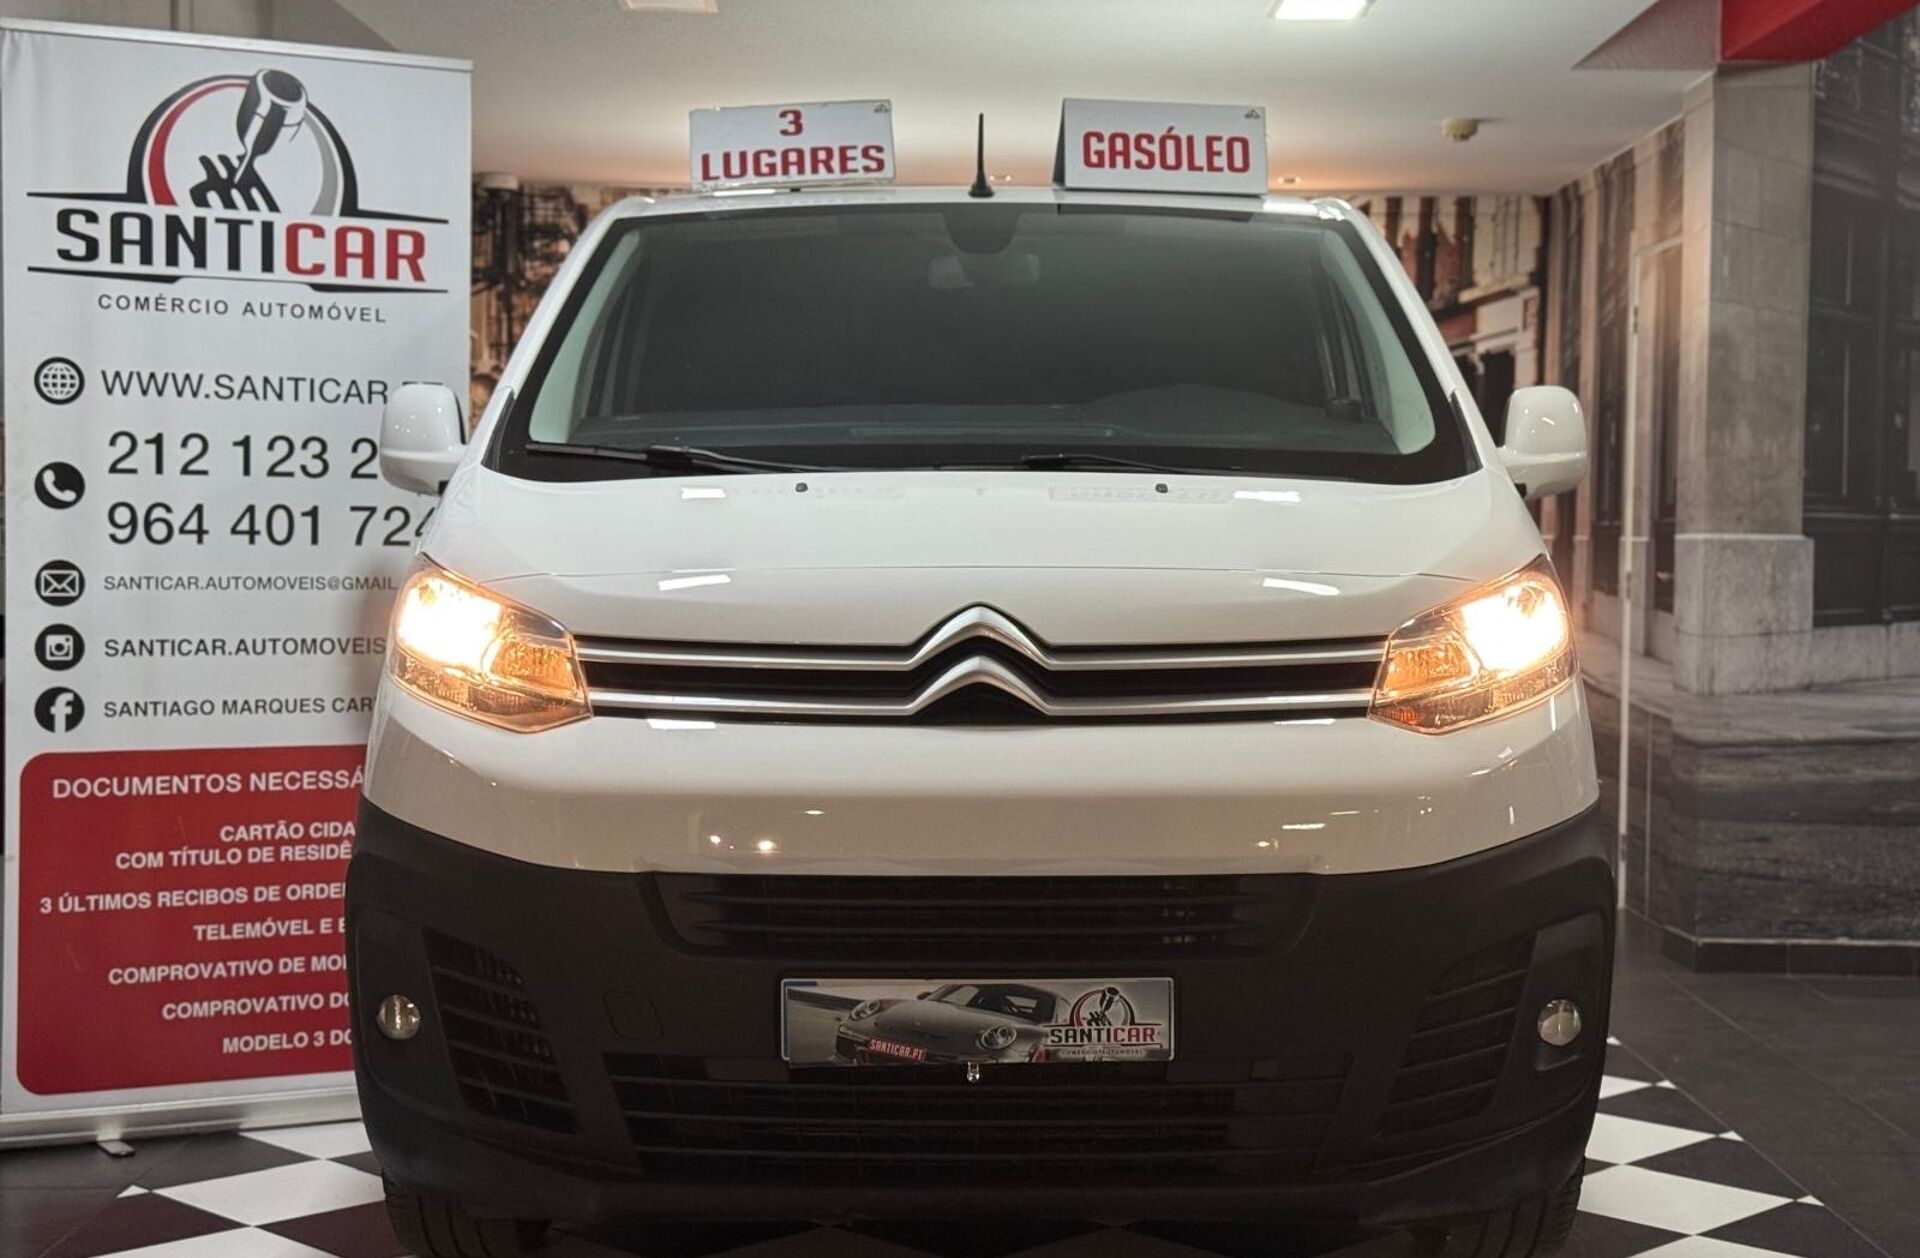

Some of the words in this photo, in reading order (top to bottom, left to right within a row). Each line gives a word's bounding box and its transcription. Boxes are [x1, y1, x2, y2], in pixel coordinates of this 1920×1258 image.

[779, 109, 803, 136] 3
[701, 145, 886, 181] LUGARES
[1082, 126, 1251, 173] GASÓLEO
[56, 207, 426, 282] SANTICAR
[98, 294, 229, 315] COMÉRCIO
[242, 302, 387, 323] AUTOMÓVEL
[101, 370, 444, 405] WWW.SANTICAR
[107, 431, 211, 475] 212
[232, 434, 330, 479] 123
[350, 437, 378, 480] 2
[107, 501, 210, 546] 964
[230, 504, 321, 547] 401
[104, 637, 386, 657] SANTICAR.AUTOMOVEIS
[103, 700, 216, 718] SANTIAGO
[222, 698, 325, 715] MARQUES
[52, 773, 242, 799] DOCUMENTOS
[220, 820, 304, 842] CARTÃO
[309, 821, 356, 839] CIDA
[116, 851, 163, 869] COM
[169, 846, 242, 867] TÍTULO
[247, 847, 273, 863] DE
[280, 839, 353, 861] RESIDÊ
[40, 897, 52, 914] 3
[59, 892, 151, 913] ÚLTIMOS
[157, 887, 248, 908] RECIBOS
[254, 885, 281, 903] DE
[286, 882, 346, 900] ORDE
[193, 919, 314, 941] TELEMÓVEL
[320, 918, 333, 934] E
[108, 960, 273, 984] COMPROVATIVO
[278, 957, 305, 974] DE
[311, 954, 347, 972] MO
[162, 992, 325, 1020] COMPROVATIVO
[223, 1033, 308, 1053] MODELO
[313, 1030, 325, 1047] 3
[1050, 1027, 1156, 1044] SANTICAR
